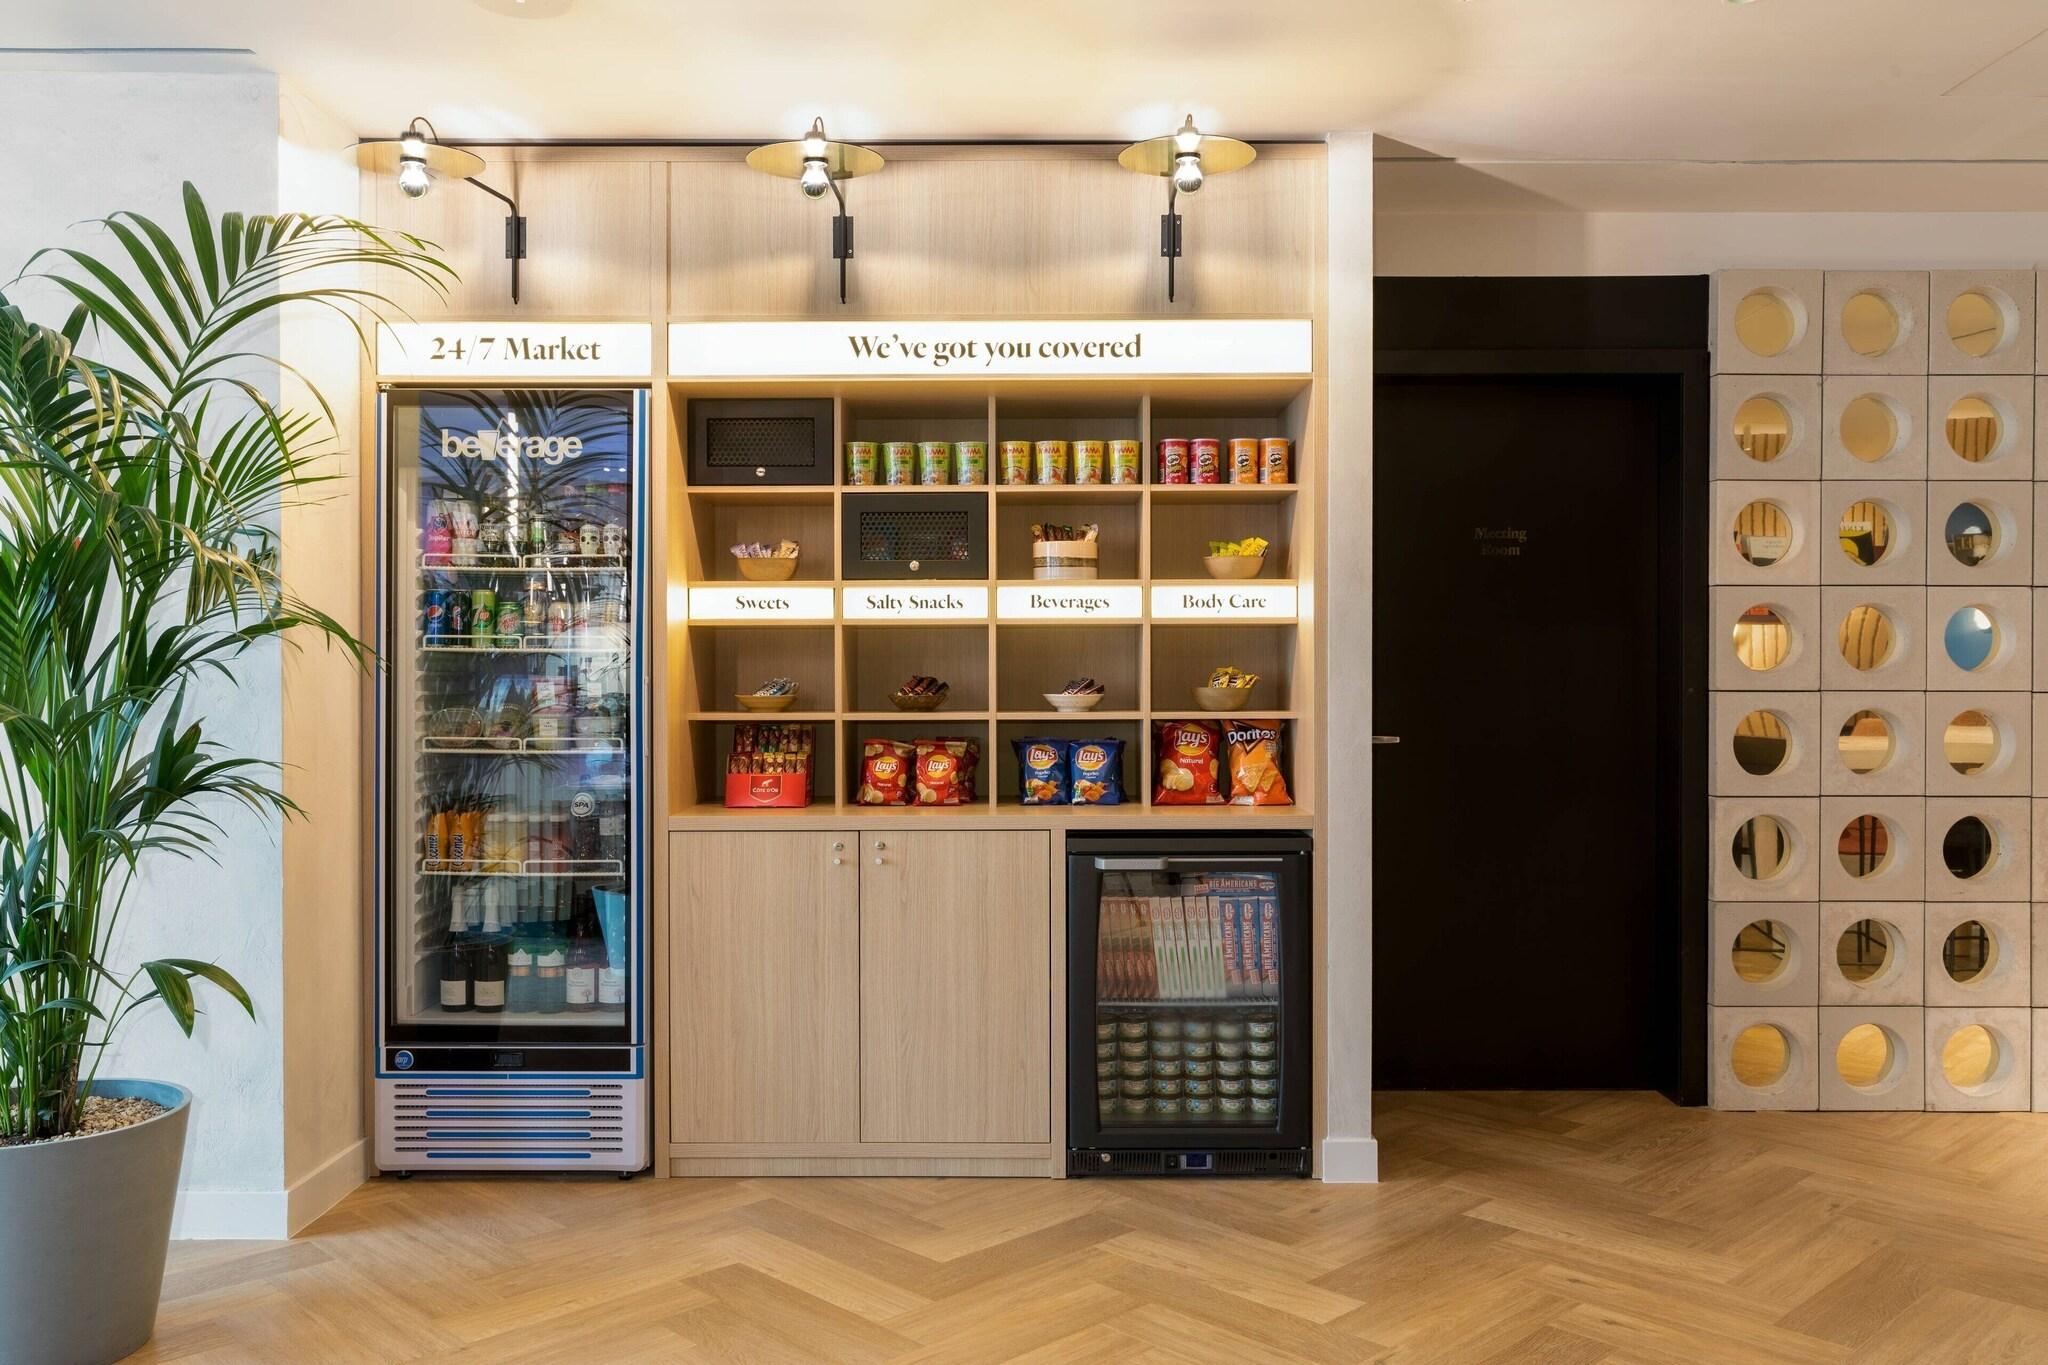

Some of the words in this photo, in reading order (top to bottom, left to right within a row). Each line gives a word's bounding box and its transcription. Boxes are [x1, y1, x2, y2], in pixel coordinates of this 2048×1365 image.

[430, 336, 496, 366] 24/7
[504, 336, 601, 361] Market
[933, 338, 978, 367] got
[985, 343, 1031, 367] you
[1039, 334, 1141, 359] covered
[736, 596, 790, 610] Sweets
[867, 595, 903, 613] Salty
[909, 595, 964, 609] Snacks
[1031, 595, 1110, 612] Beverages
[1183, 594, 1223, 613] Body
[1229, 594, 1267, 609] Care
[1176, 730, 1208, 747] Lay's
[1227, 729, 1276, 745] Doritos
[1030, 748, 1056, 762] Lay's
[1078, 749, 1105, 763] Lay's
[928, 759, 950, 773] Lay's
[574, 801, 589, 809] SPA
